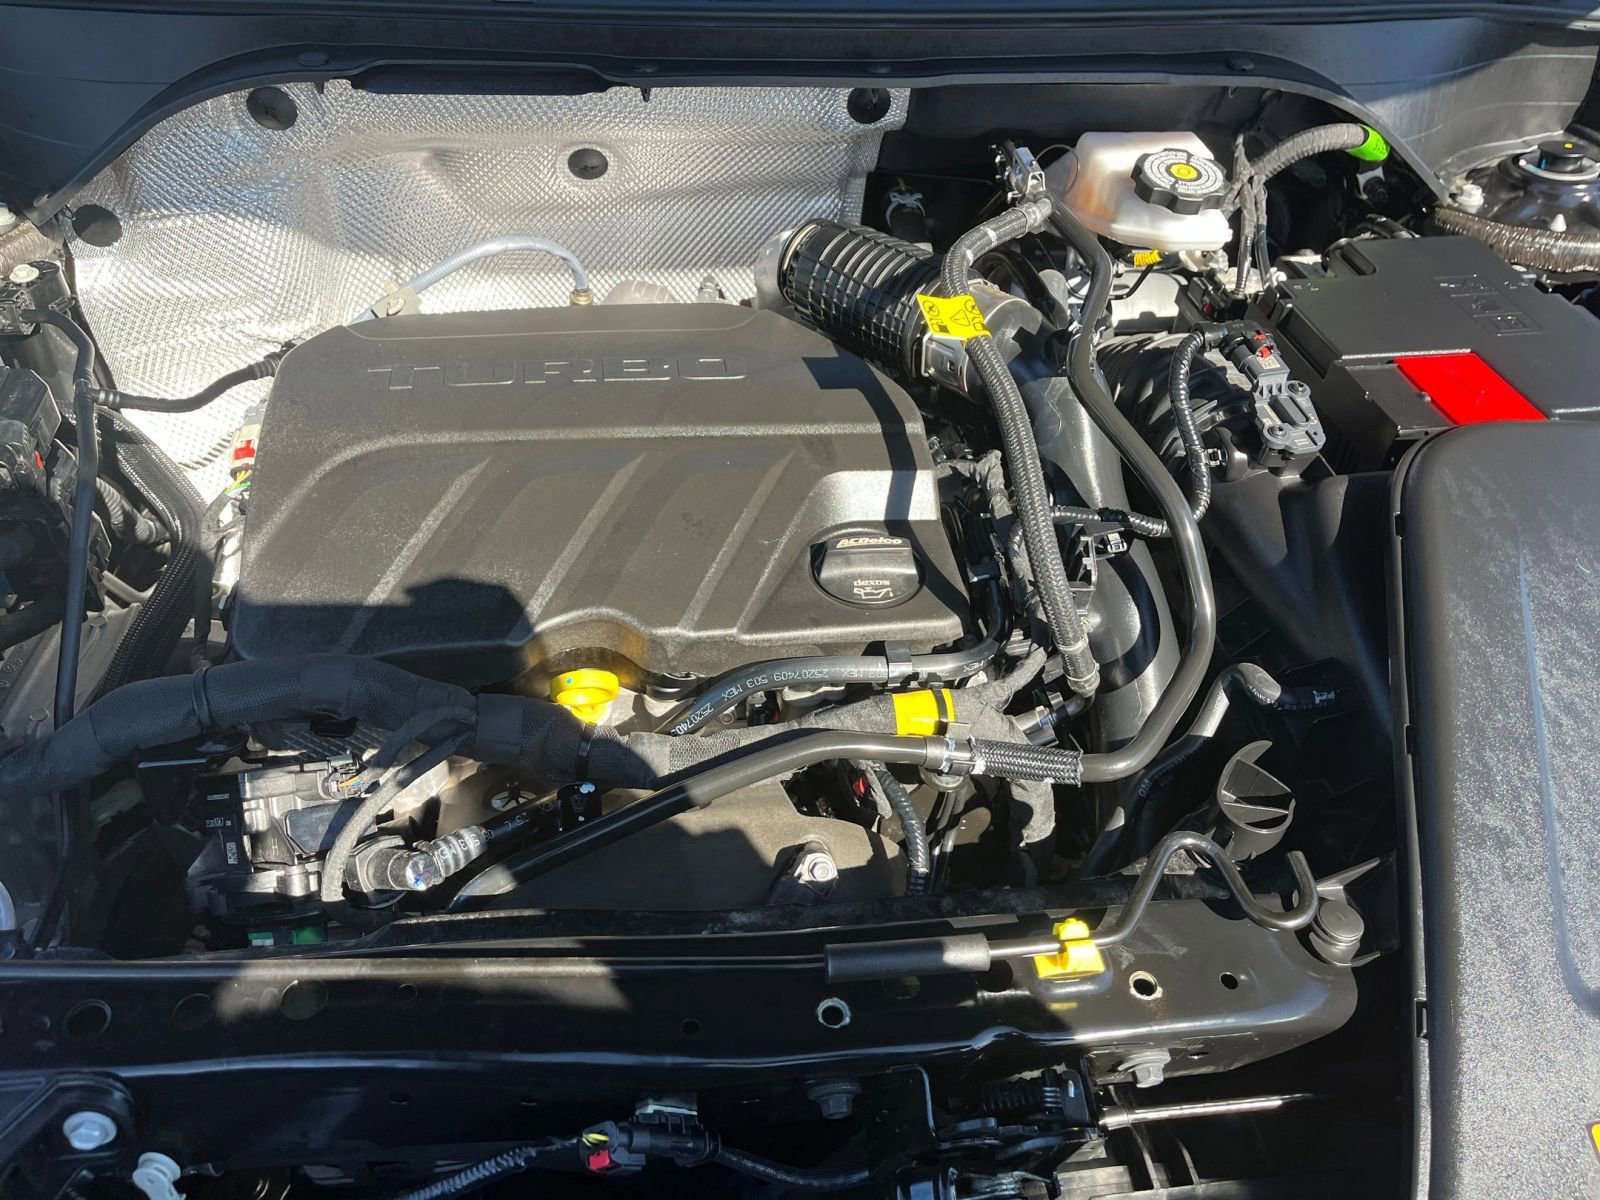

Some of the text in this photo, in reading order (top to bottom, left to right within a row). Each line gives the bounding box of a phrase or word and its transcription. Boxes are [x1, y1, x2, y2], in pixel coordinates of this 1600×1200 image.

[366, 356, 750, 390] TURBO
[836, 537, 903, 548] ACDelco
[853, 579, 891, 587] dexos
[773, 665, 829, 682] 25207409
[747, 674, 768, 689] 503
[721, 685, 743, 701] MEX
